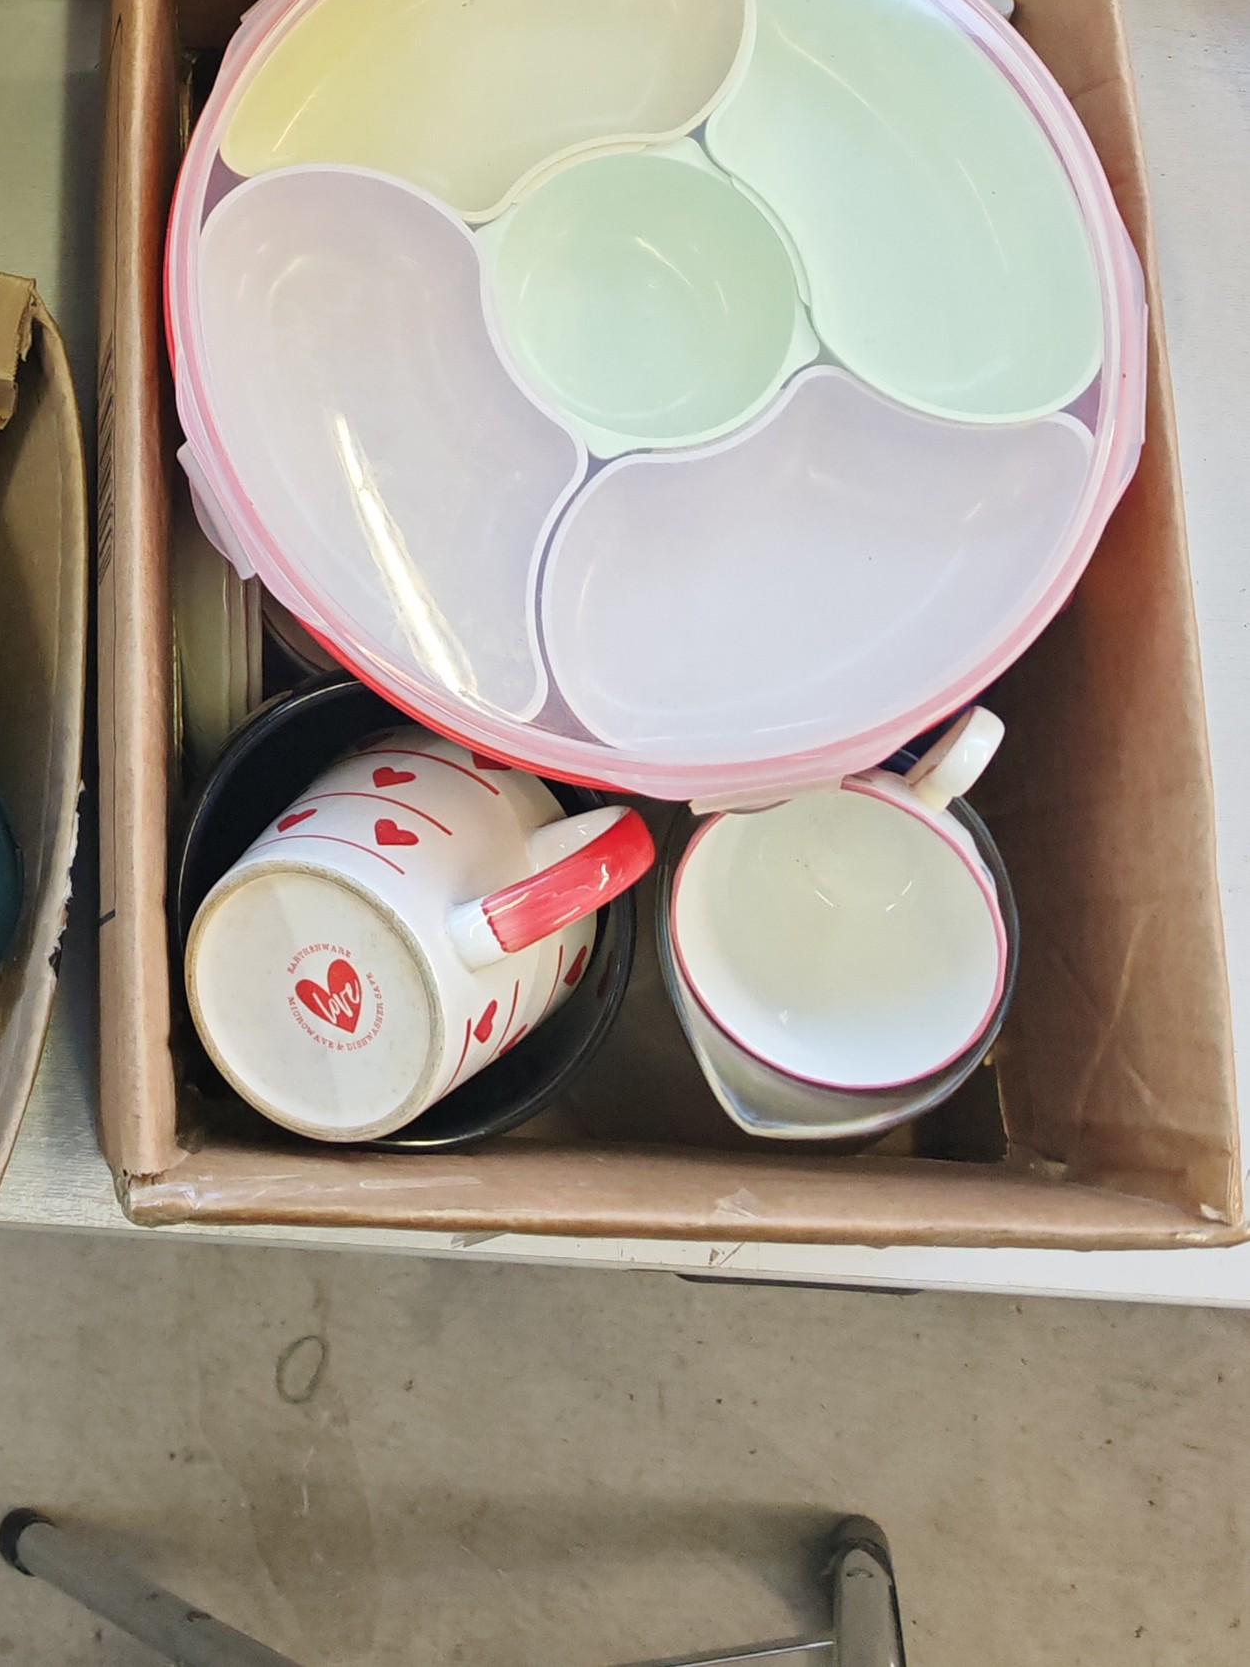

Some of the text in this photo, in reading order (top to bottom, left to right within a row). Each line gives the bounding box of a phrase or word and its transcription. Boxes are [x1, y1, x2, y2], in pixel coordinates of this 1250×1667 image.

[287, 943, 352, 974] EARTHENWARE
[287, 996, 334, 1050] MICROWAVE
[347, 1002, 384, 1051] DISHWASHER
[312, 979, 360, 1024] love
